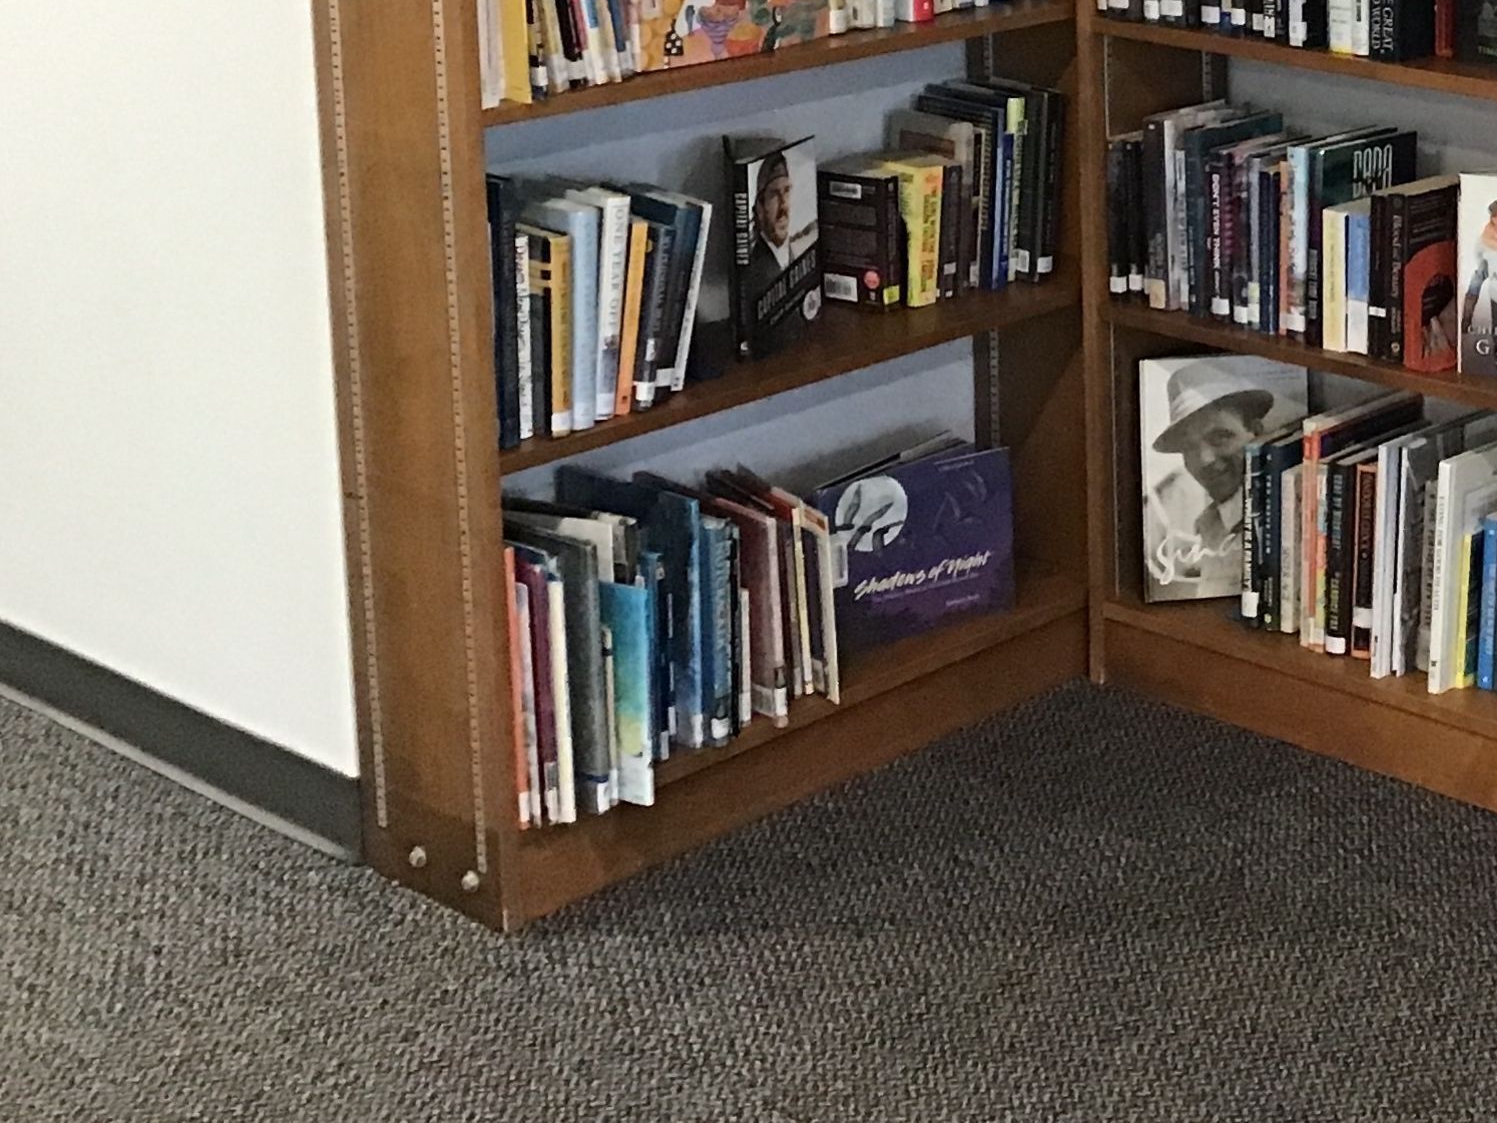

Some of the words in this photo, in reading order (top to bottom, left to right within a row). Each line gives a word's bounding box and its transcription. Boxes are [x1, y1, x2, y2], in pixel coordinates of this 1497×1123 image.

[1371, 7, 1381, 50] WORLD
[1211, 174, 1220, 206] DON'T
[612, 209, 624, 245] ONE
[1212, 209, 1220, 235] EVEN
[1392, 215, 1401, 246] Blood
[611, 252, 622, 292] YEAR
[608, 299, 618, 327] OFF
[853, 569, 926, 602] Shadows
[928, 562, 944, 582] of
[945, 550, 992, 579] Night
